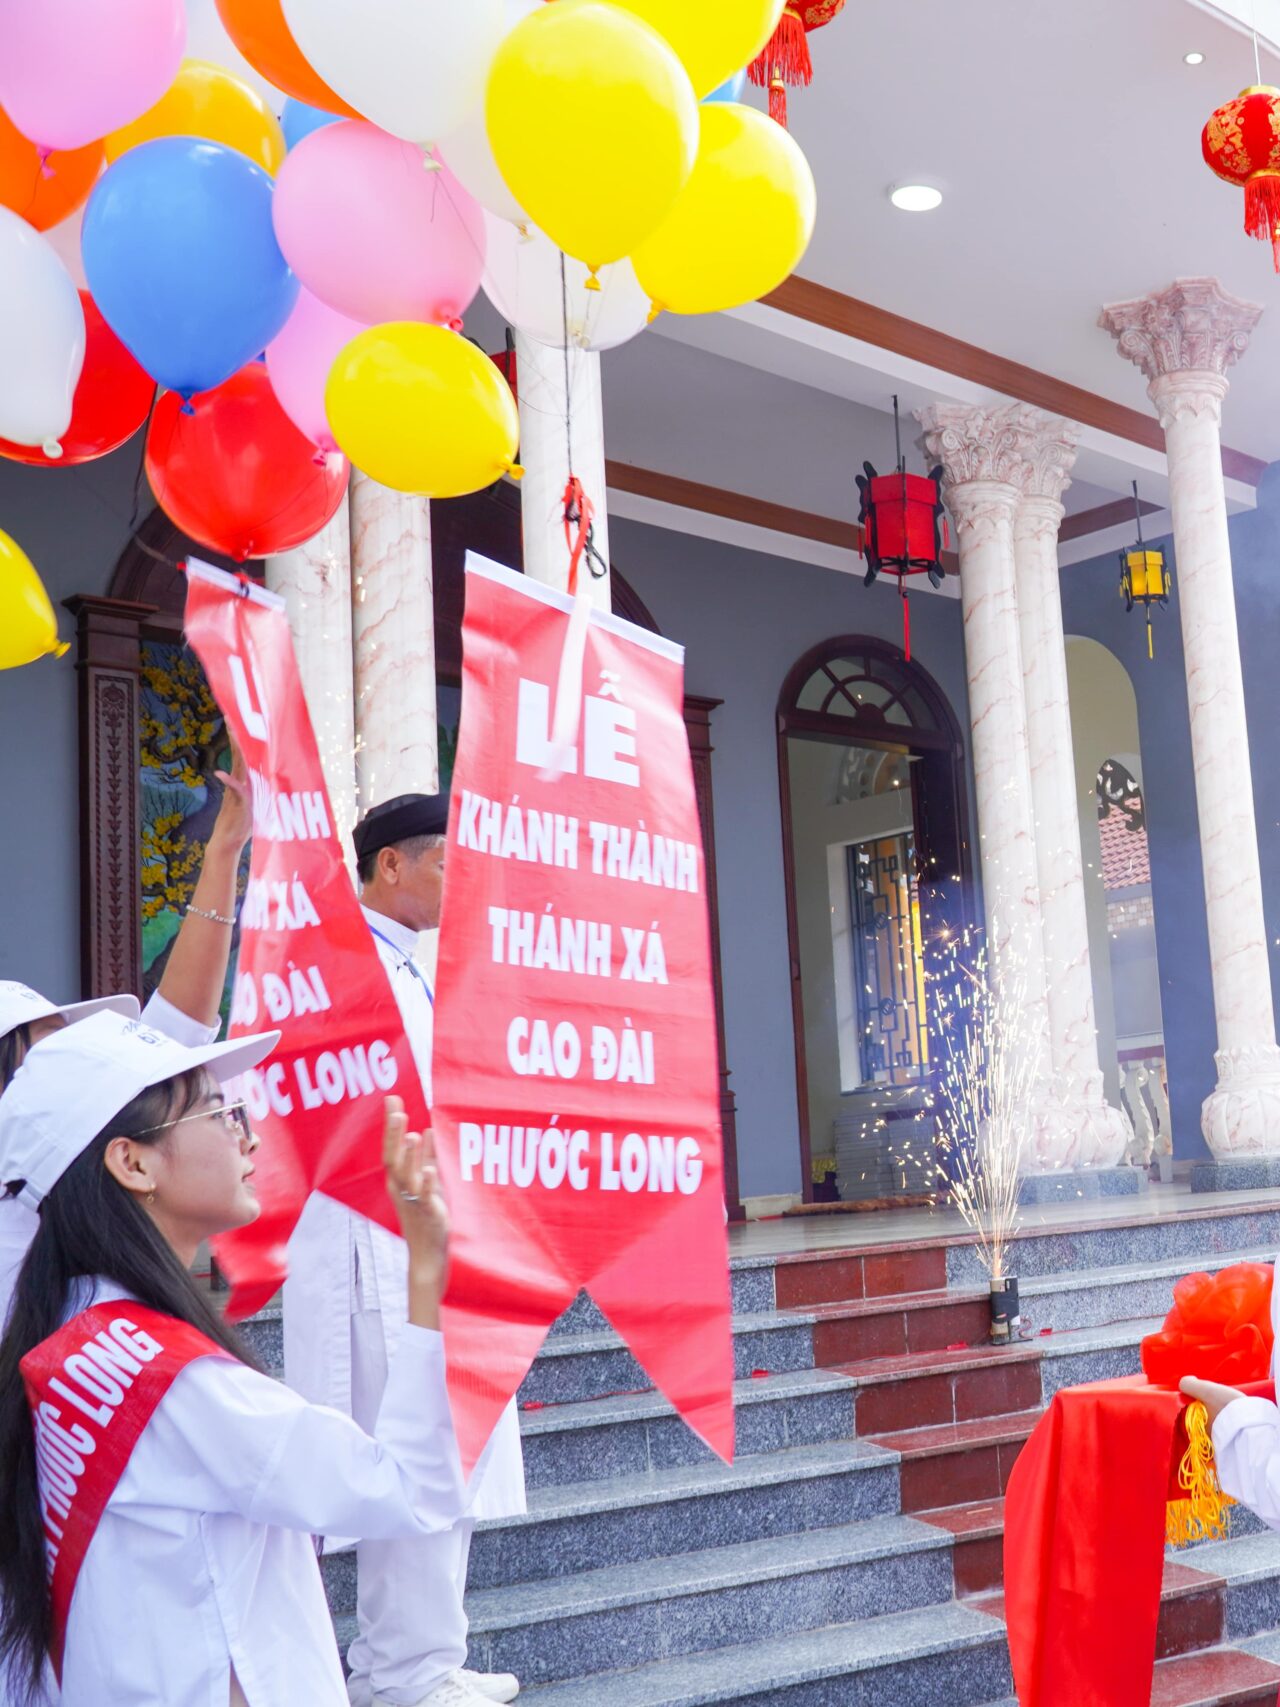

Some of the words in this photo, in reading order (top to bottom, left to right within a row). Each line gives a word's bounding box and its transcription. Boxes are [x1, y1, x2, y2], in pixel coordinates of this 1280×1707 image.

[515, 670, 640, 789] LỄ
[457, 790, 578, 870] KHÁNH
[589, 810, 699, 893] THÀNH
[272, 870, 321, 932] XÁ
[488, 902, 611, 978] THÁNH
[621, 922, 668, 985] XÁ
[262, 960, 333, 1023] ĐÀI
[294, 1039, 399, 1111] LONG
[506, 1016, 581, 1079] CAO
[590, 1016, 655, 1086] ĐÀI
[459, 1114, 589, 1191] PHƯỚC
[599, 1132, 703, 1195] LONG
[47, 1317, 165, 1428] LONG
